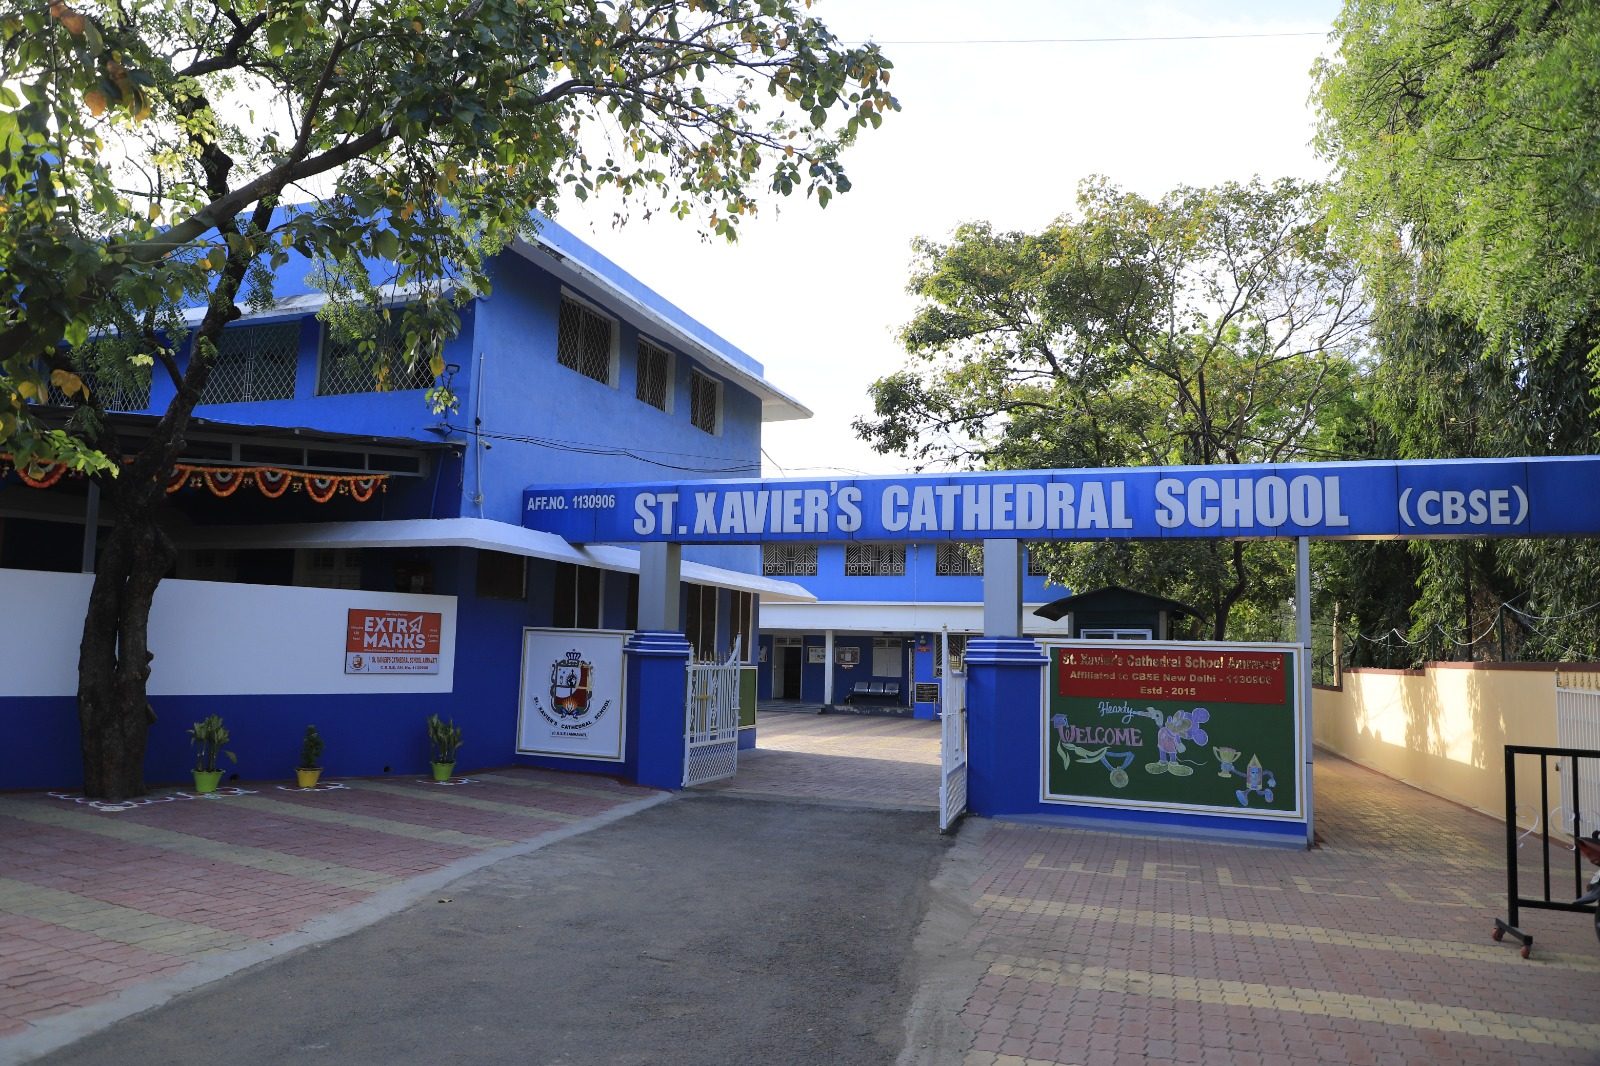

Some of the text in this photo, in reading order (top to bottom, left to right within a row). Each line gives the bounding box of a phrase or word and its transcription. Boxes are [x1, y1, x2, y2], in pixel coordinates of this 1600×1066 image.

[527, 494, 616, 511] AFF.NO. 1130906
[633, 474, 1529, 535] ST. XAVIER'S CATHEDRAL SCHOOL (CBSE)
[363, 632, 426, 649] MARKS
[1062, 653, 1077, 665] St.
[1127, 654, 1181, 668] Cathedral
[1184, 656, 1224, 669] School
[1070, 670, 1116, 680] Affiliated
[1118, 671, 1129, 680] to
[1131, 672, 1160, 681] CBSE
[1163, 673, 1186, 682] New
[1189, 674, 1217, 683] Delhi
[1140, 686, 1163, 695] Estd
[1171, 687, 1196, 696] 2015
[561, 720, 592, 730] CATHEDRAL
[594, 699, 611, 720] SCHOOL
[1098, 701, 1134, 724] Hearty
[1058, 724, 1143, 747] WELCOME
